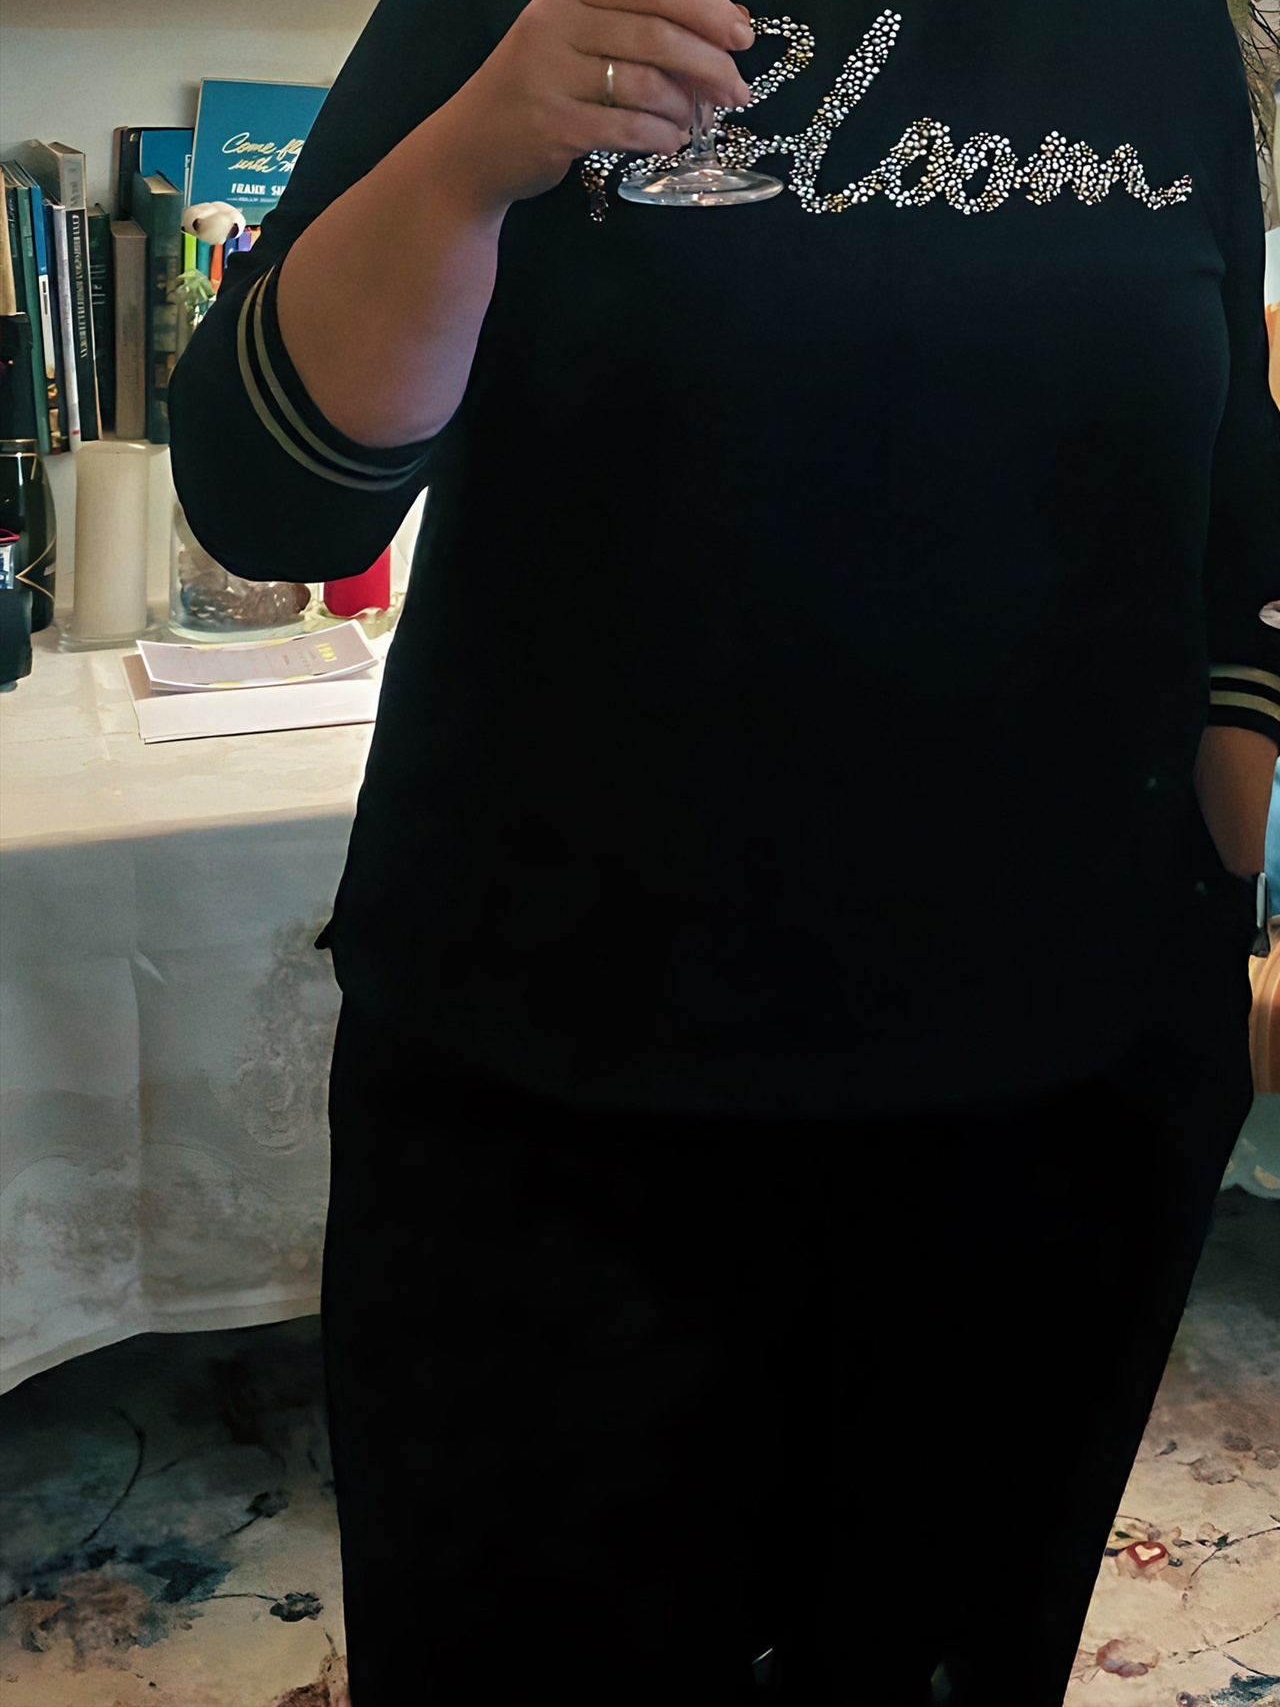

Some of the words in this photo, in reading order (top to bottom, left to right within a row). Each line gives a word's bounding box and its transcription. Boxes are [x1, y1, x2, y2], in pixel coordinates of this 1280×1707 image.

[222, 132, 278, 154] Come
[228, 155, 278, 173] with
[231, 183, 266, 195] FRANK
